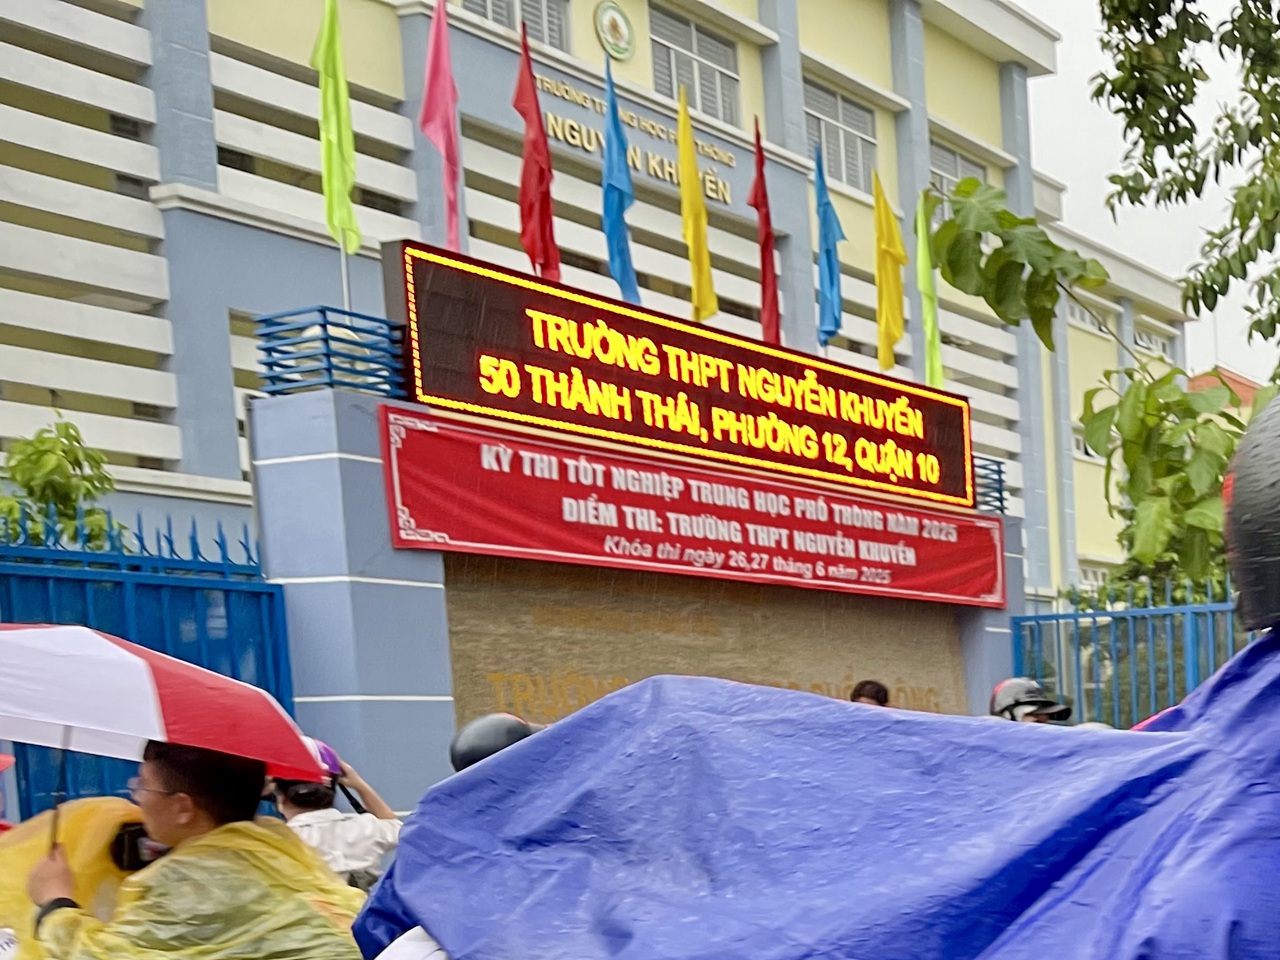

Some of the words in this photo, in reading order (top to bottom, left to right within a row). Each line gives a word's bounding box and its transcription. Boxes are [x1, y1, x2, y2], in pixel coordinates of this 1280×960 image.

[545, 111, 642, 172] NGUN
[646, 150, 732, 205] KHẾN
[592, 96, 636, 128] TRNG
[479, 354, 521, 399] 50
[524, 364, 633, 422] THÀNH
[635, 389, 709, 443] THÁI,
[711, 407, 819, 460] PHƯỜNG
[822, 431, 853, 473] 12,
[855, 437, 914, 483] QUẬN
[916, 452, 941, 485] 10
[525, 308, 661, 376] TRƯỜNG
[662, 344, 734, 393] THPT
[737, 364, 837, 418] NGUYỄN
[839, 389, 924, 440] KHUYẾN
[480, 443, 514, 473] KỲ
[518, 450, 559, 481] THI
[563, 455, 606, 487] TỐT
[611, 466, 684, 502] NGHIỆP
[687, 479, 750, 510] TRUNG
[753, 490, 791, 518] HỌC
[794, 496, 828, 523] PHỔ
[831, 503, 884, 531] THÔNG
[922, 519, 958, 542] 2025
[561, 493, 618, 527] ĐIỂM
[621, 505, 663, 533] THI:
[665, 511, 743, 544] TRƯỜNG
[745, 523, 790, 550] THPT
[858, 540, 916, 566] KHUYẾN
[603, 535, 653, 558] Khóa
[656, 541, 682, 561] thi
[683, 545, 725, 569] ngày
[728, 550, 770, 571] 26,27
[772, 556, 813, 579] tháng
[814, 561, 826, 577] 6
[828, 565, 858, 580] năm
[860, 566, 892, 584] 2025
